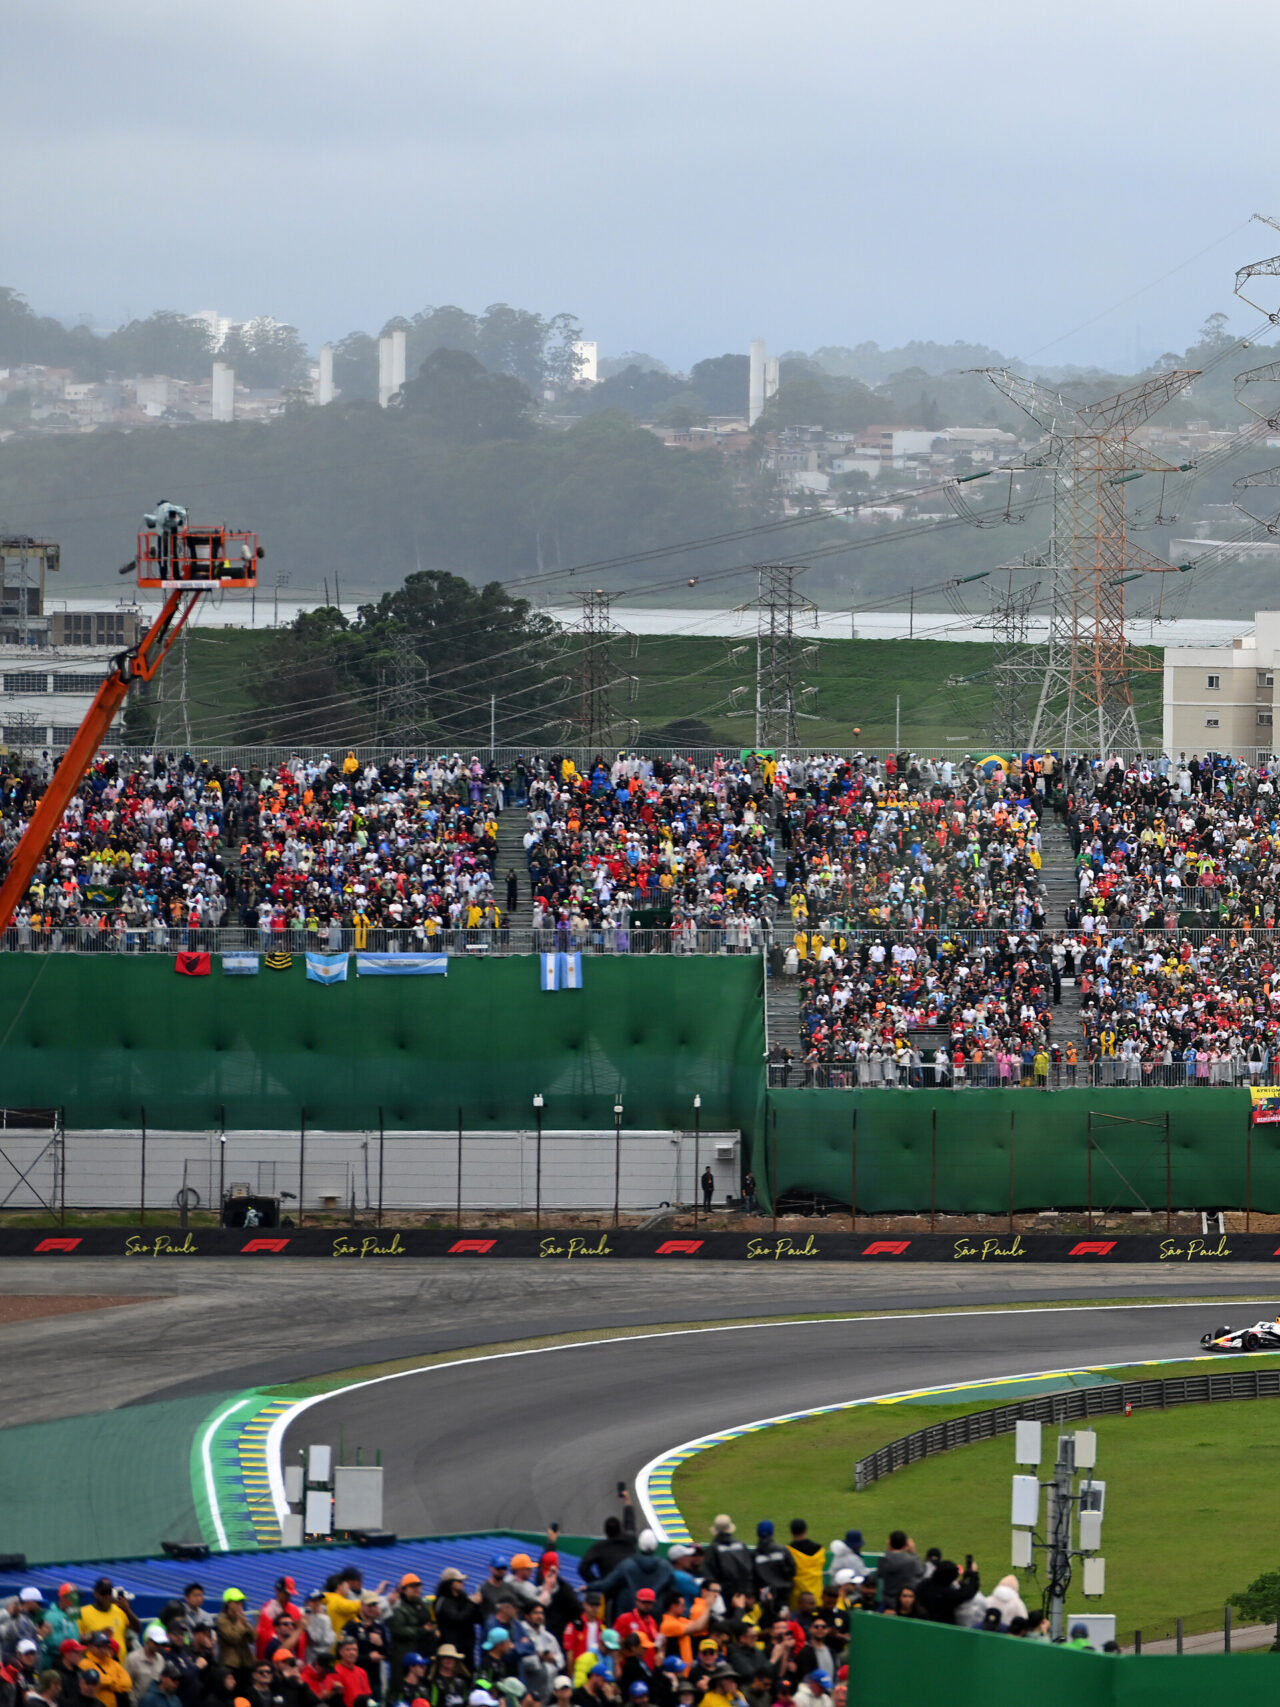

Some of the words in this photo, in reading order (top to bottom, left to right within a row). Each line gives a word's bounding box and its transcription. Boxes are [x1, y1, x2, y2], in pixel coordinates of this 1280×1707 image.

[125, 1236, 150, 1256] São
[154, 1233, 198, 1257] Paulo
[332, 1237, 357, 1257] São
[361, 1234, 406, 1258] Paulo
[540, 1238, 565, 1258] São
[568, 1234, 612, 1259] Paulo
[746, 1238, 772, 1258] São
[776, 1234, 820, 1260] Paulo
[954, 1238, 980, 1259] São
[982, 1235, 1027, 1260] Paulo
[1160, 1238, 1185, 1260] São
[1188, 1235, 1232, 1260] Paulo
